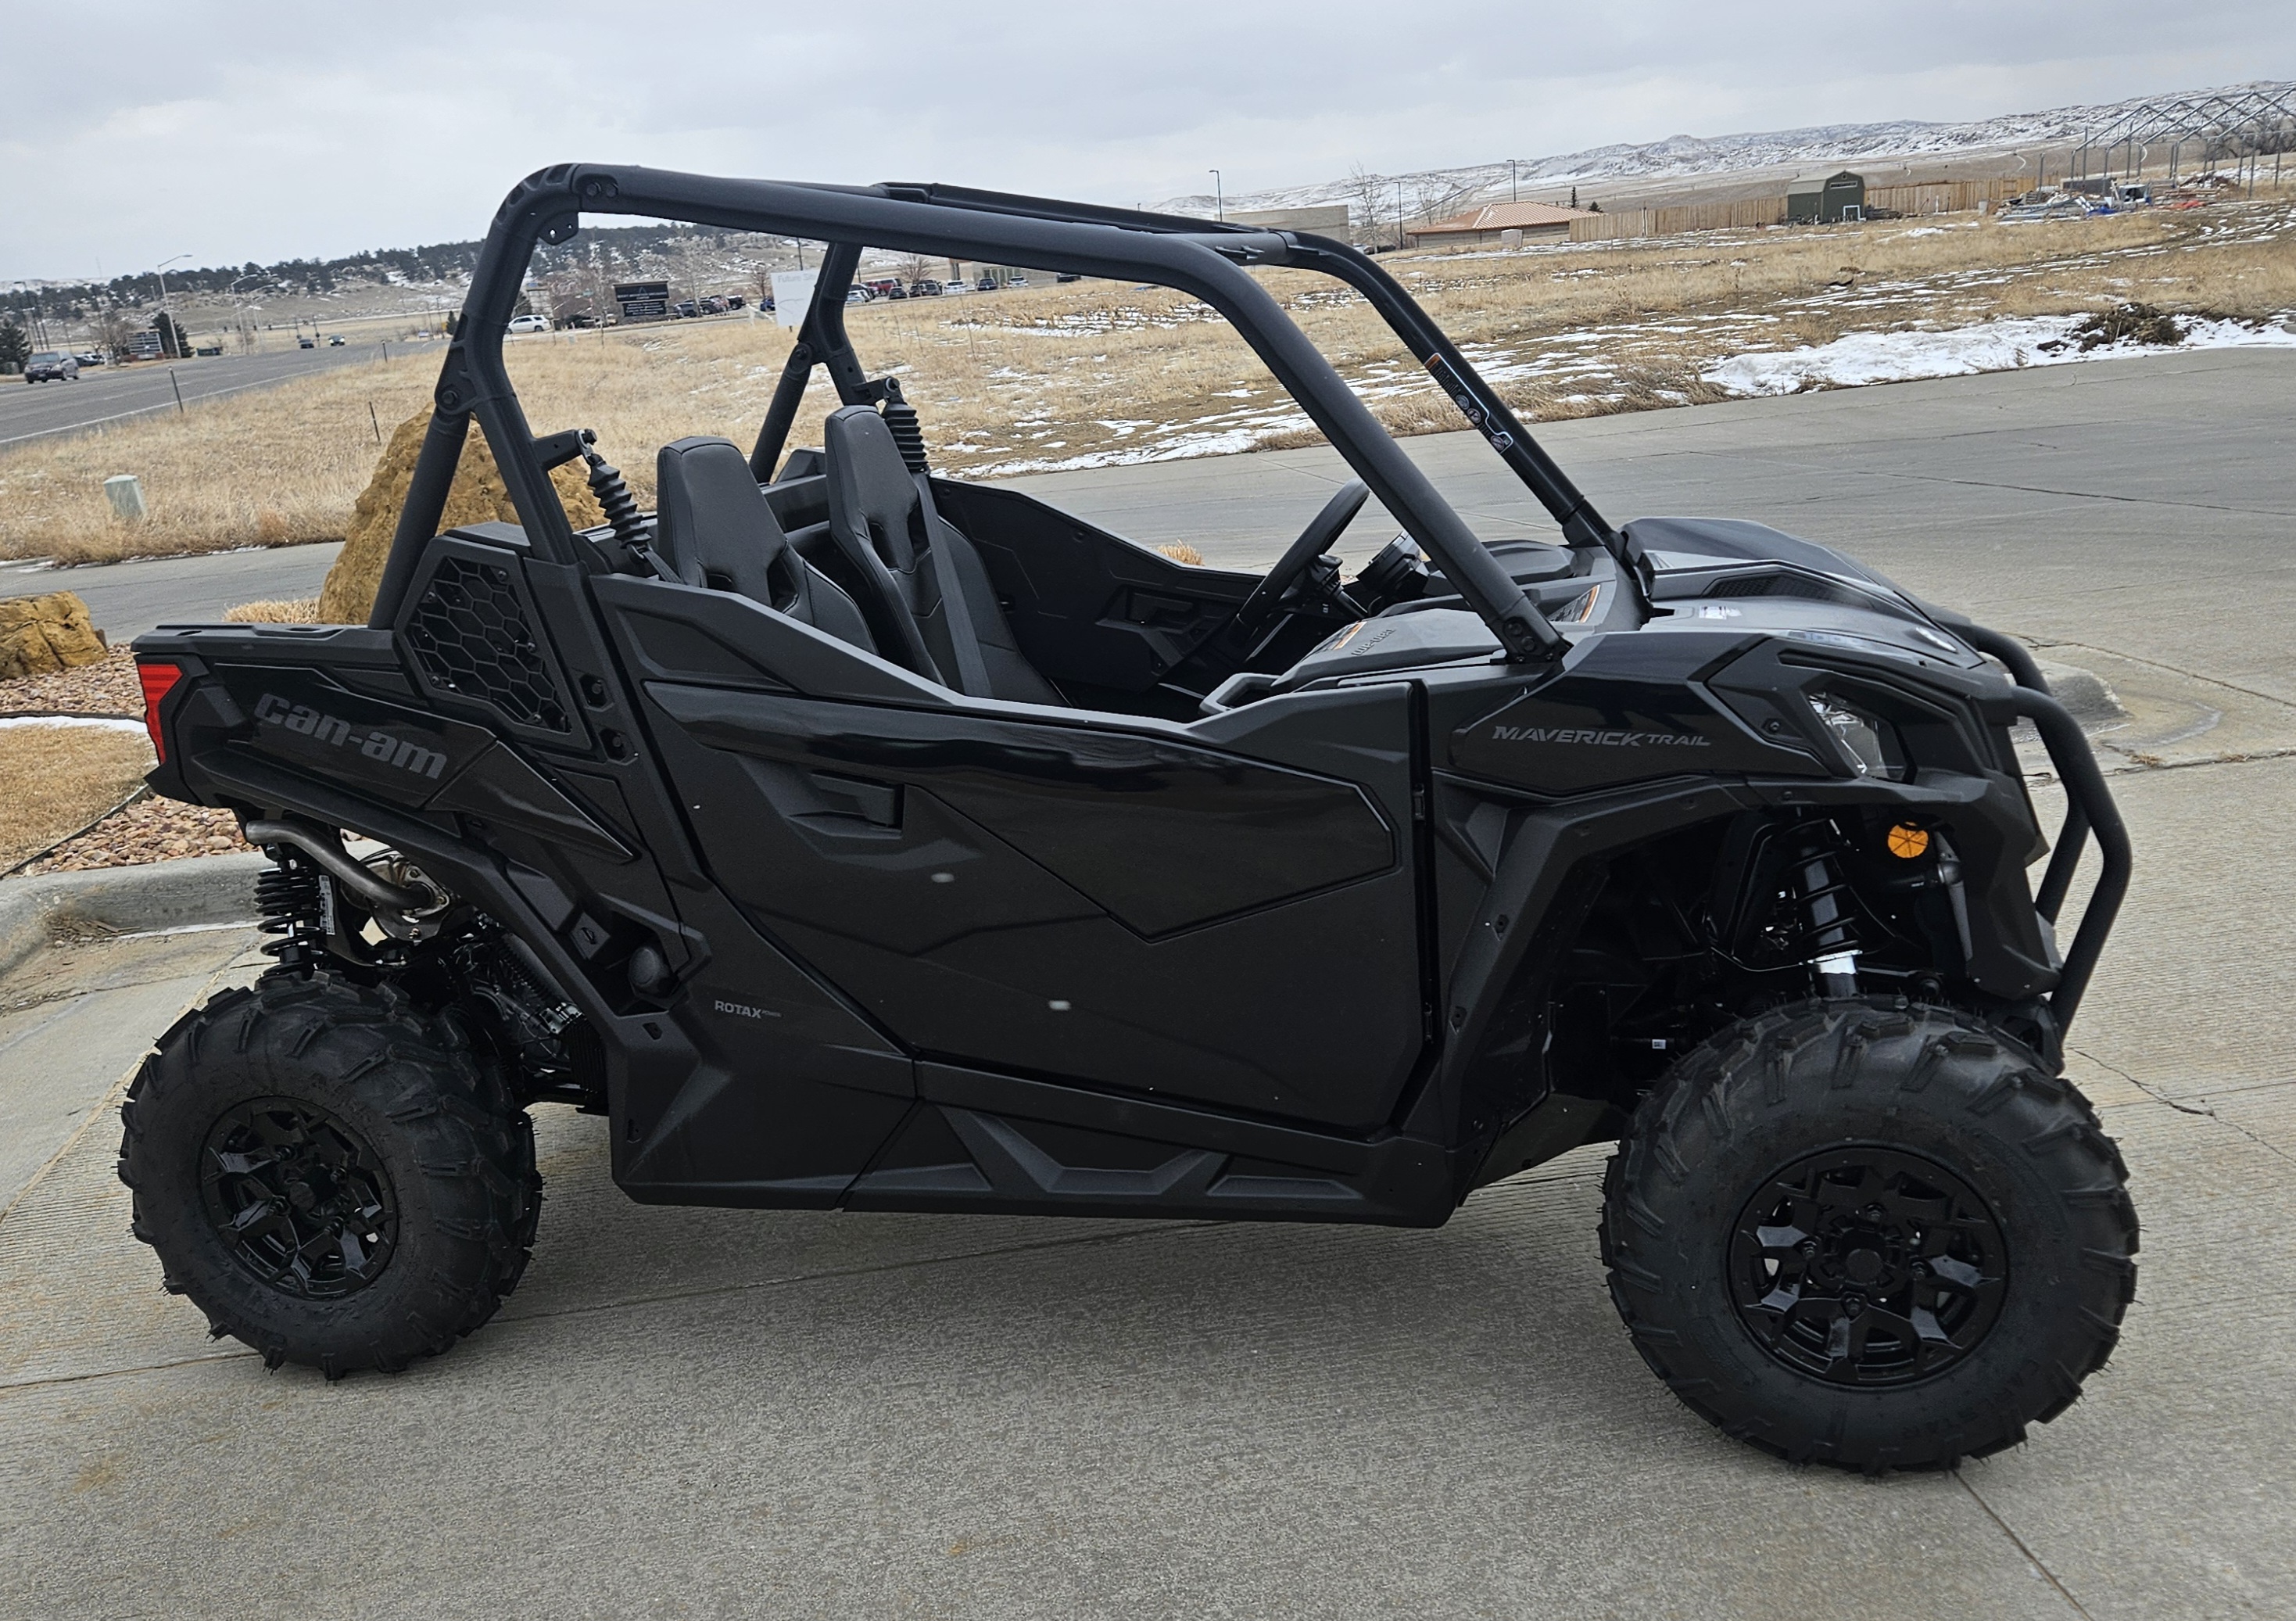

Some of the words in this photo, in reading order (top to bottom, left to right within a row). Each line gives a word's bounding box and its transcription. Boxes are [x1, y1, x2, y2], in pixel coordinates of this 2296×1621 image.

[254, 693, 447, 780] can-am
[1492, 726, 1641, 747] MAVERICK
[1642, 733, 1711, 747] TRAIL
[715, 1000, 761, 1019] ROTAX
